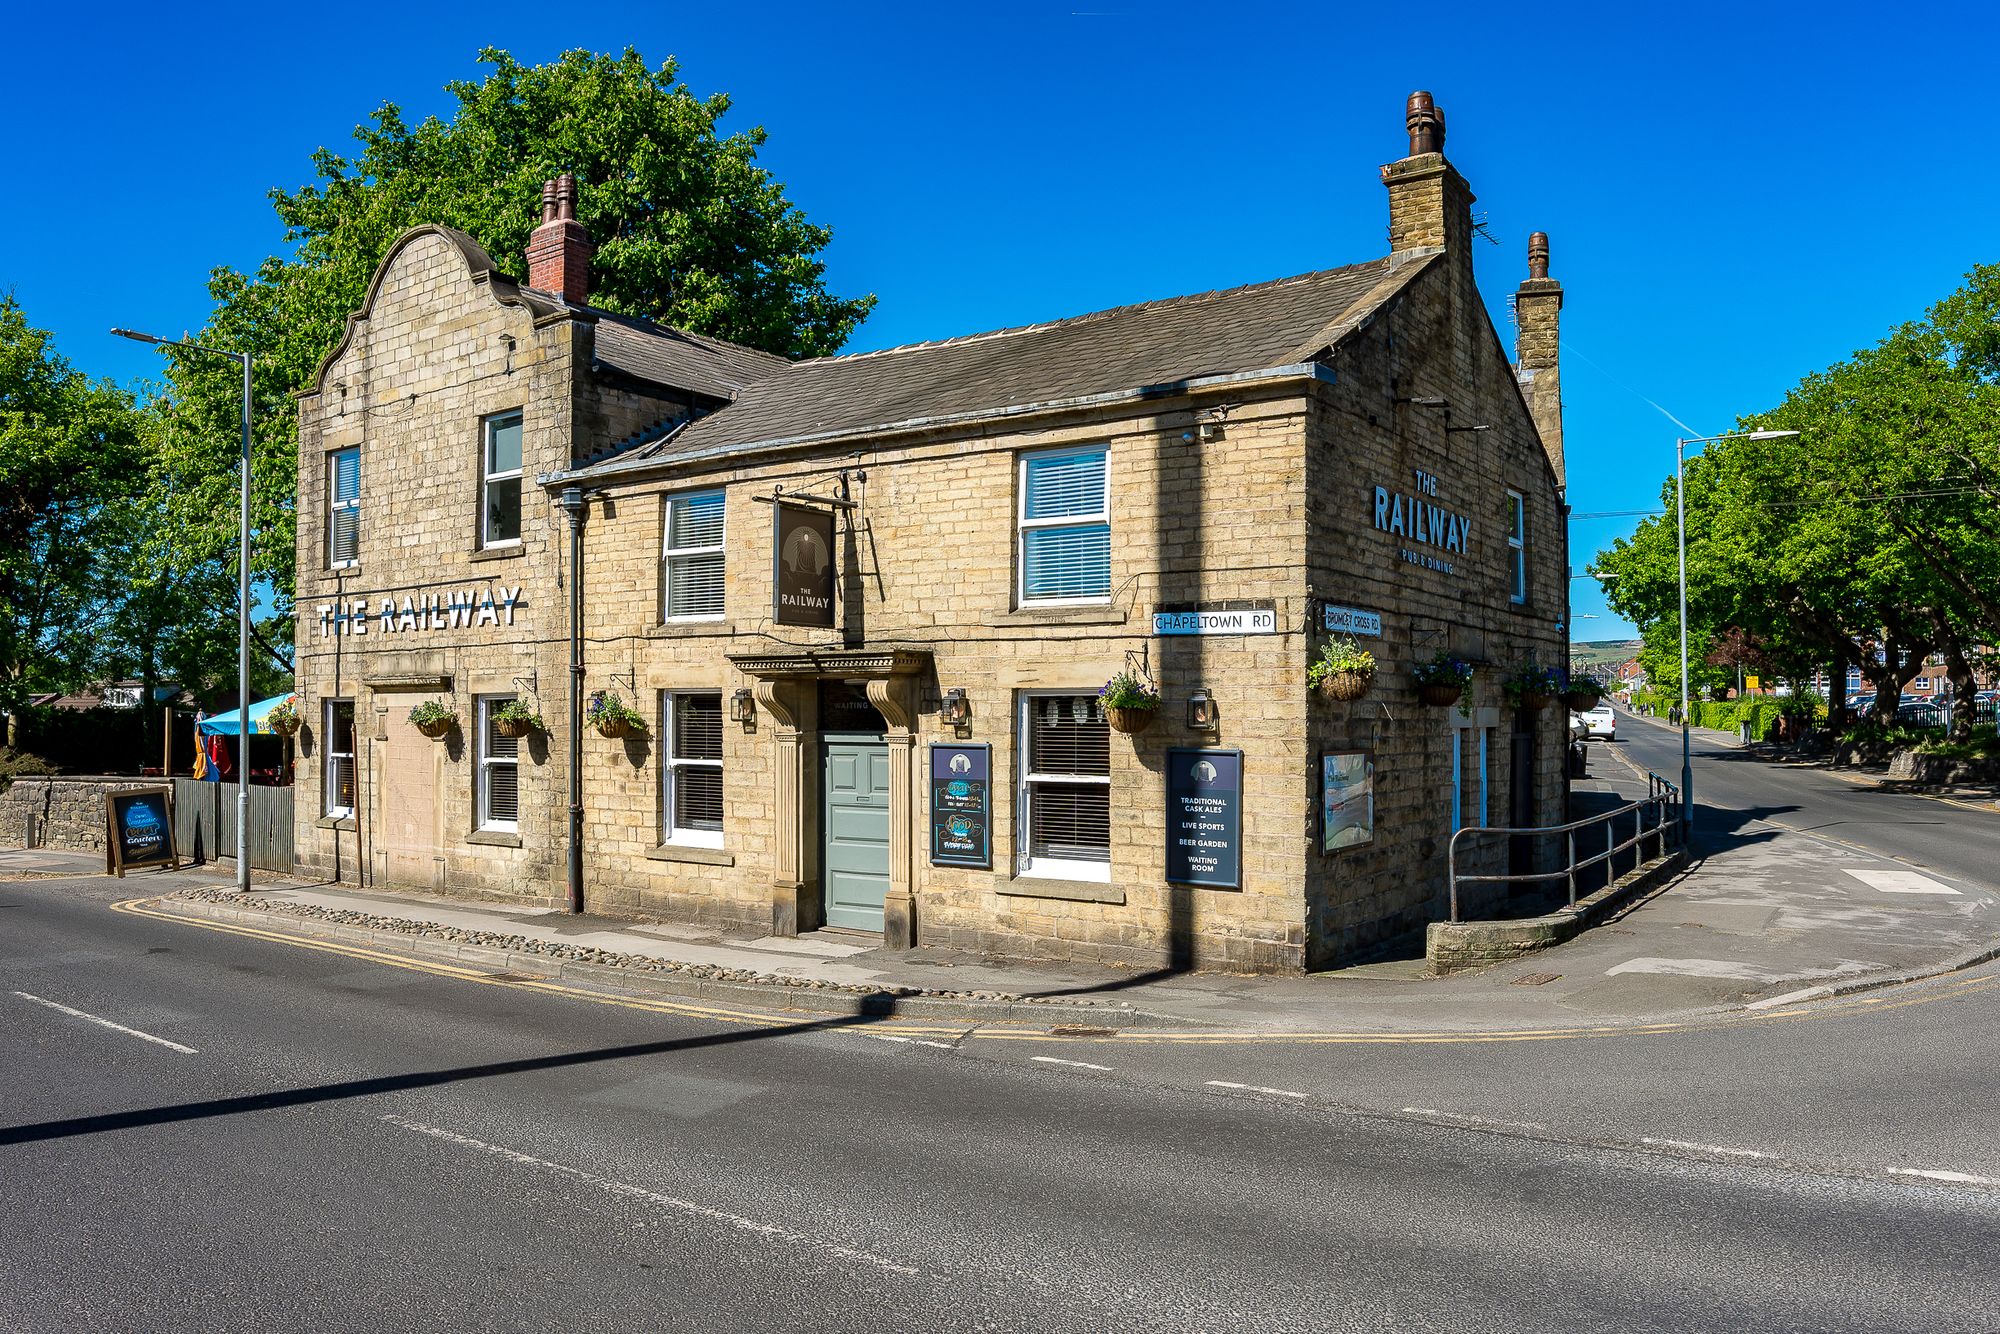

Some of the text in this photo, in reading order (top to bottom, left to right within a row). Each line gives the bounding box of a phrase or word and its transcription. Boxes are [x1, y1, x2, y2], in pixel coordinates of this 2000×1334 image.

[1416, 470, 1437, 497] THE
[1375, 485, 1471, 555] RAILWAY
[1402, 549, 1454, 575] PUB & DINING
[800, 587, 811, 595] THE
[781, 594, 829, 609] RAILWAY
[316, 586, 522, 637] THE RAILWAY
[1155, 614, 1271, 629] CHAPELTOWN RD
[1327, 611, 1352, 627] BROMLEY
[1354, 615, 1370, 629] CROSS
[834, 701, 868, 710] WAITING
[1180, 797, 1227, 806] TRADITIONAL
[1184, 805, 1222, 814] CASK ALES
[1198, 823, 1225, 831] SPORTS
[1179, 838, 1228, 848] BEER GARDEN
[1187, 856, 1218, 865] WAITING
[1191, 864, 1214, 872] ROOM
